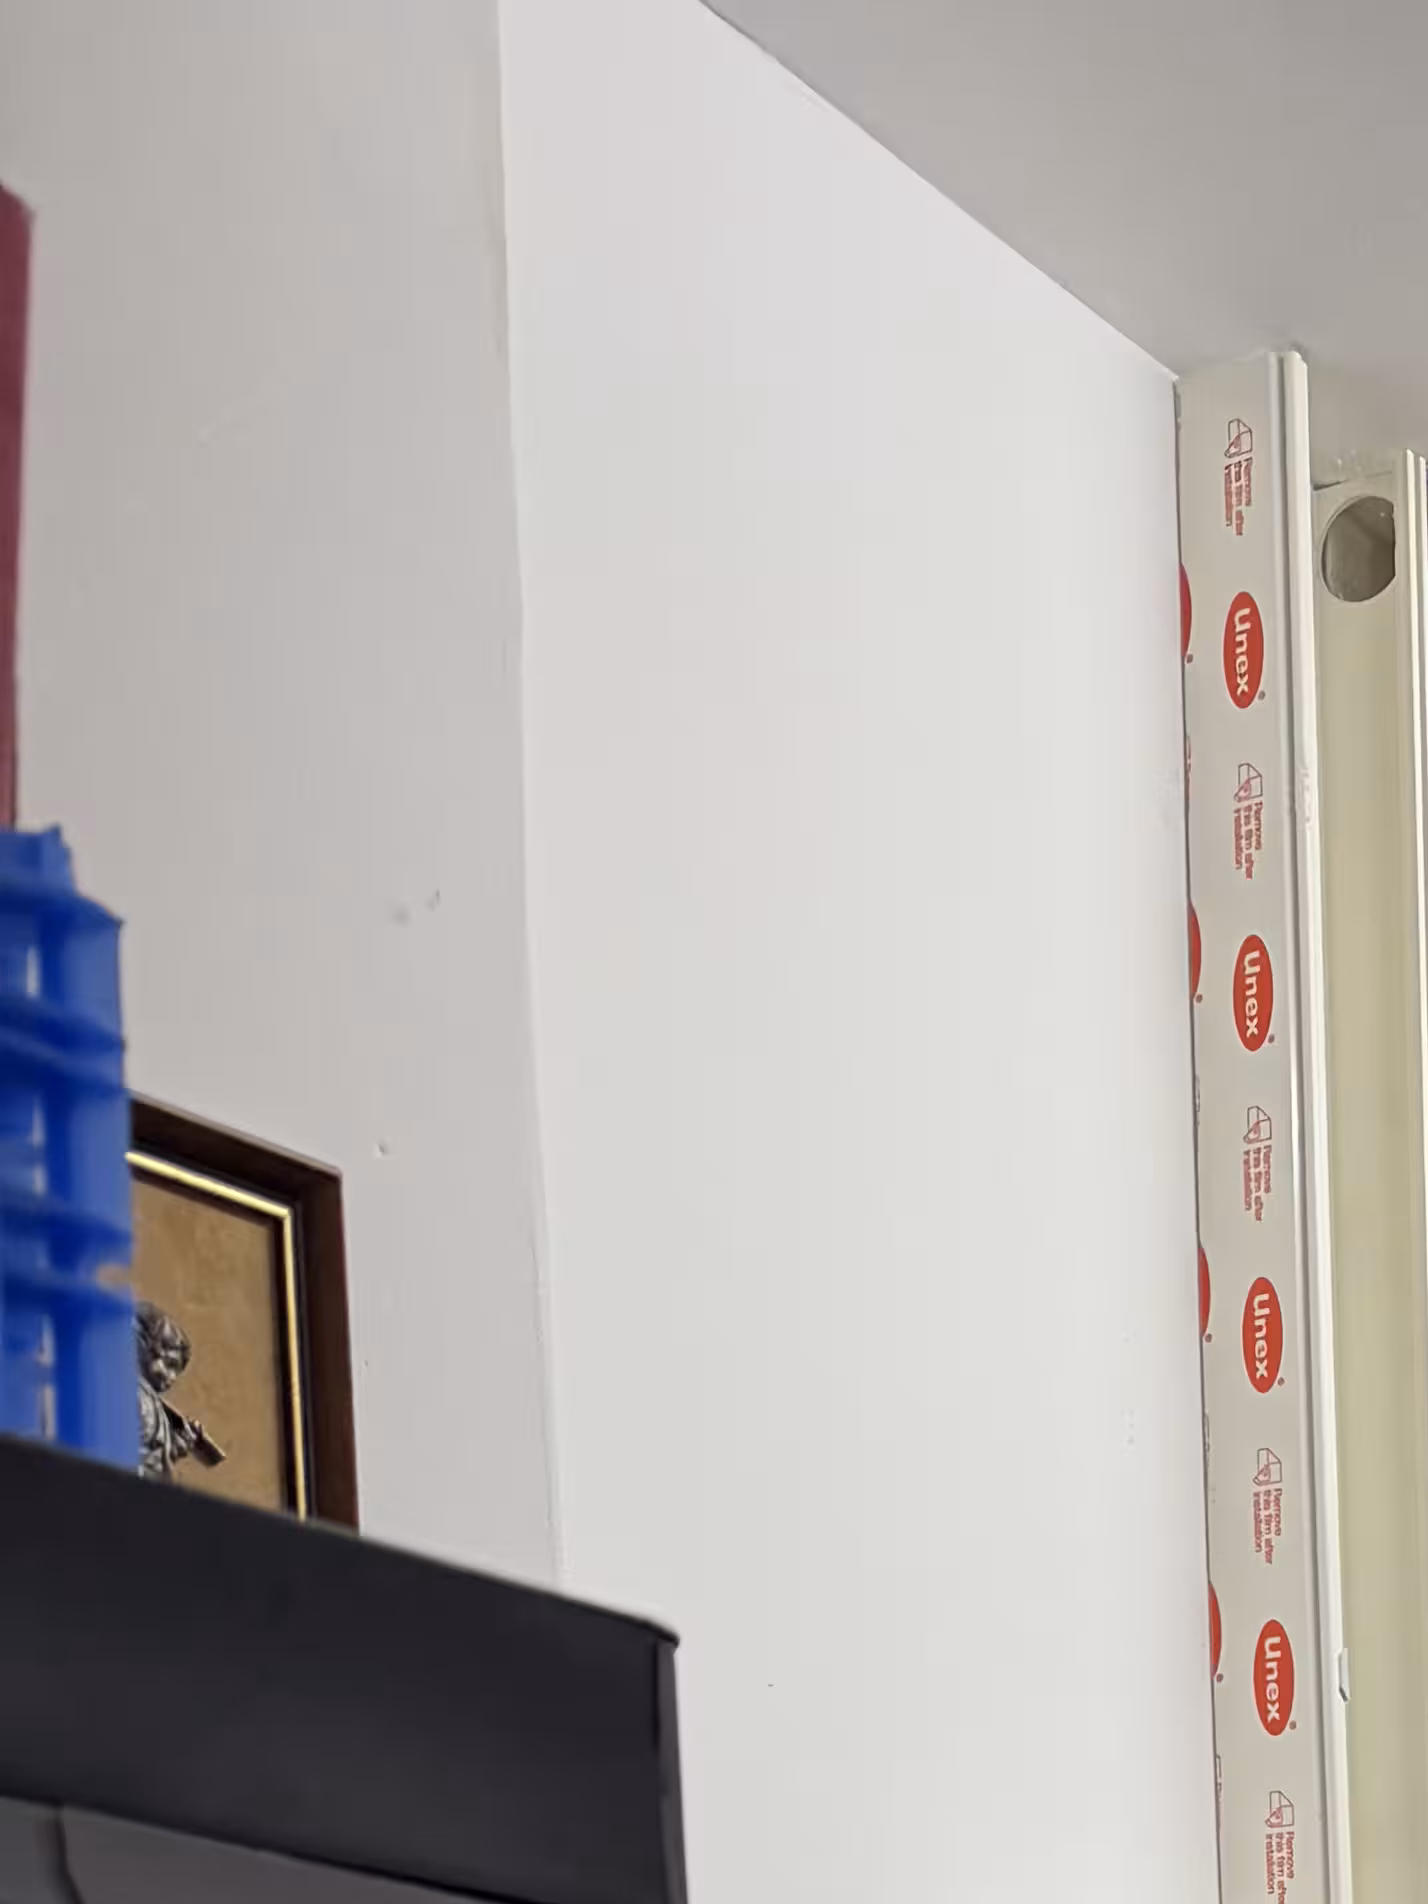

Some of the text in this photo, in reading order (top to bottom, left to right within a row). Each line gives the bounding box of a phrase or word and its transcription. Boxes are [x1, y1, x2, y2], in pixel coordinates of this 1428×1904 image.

[1233, 607, 1252, 695] Unex
[1244, 951, 1261, 1038] Unex
[1254, 1294, 1270, 1380] Unex
[1265, 1636, 1282, 1723] Unex
